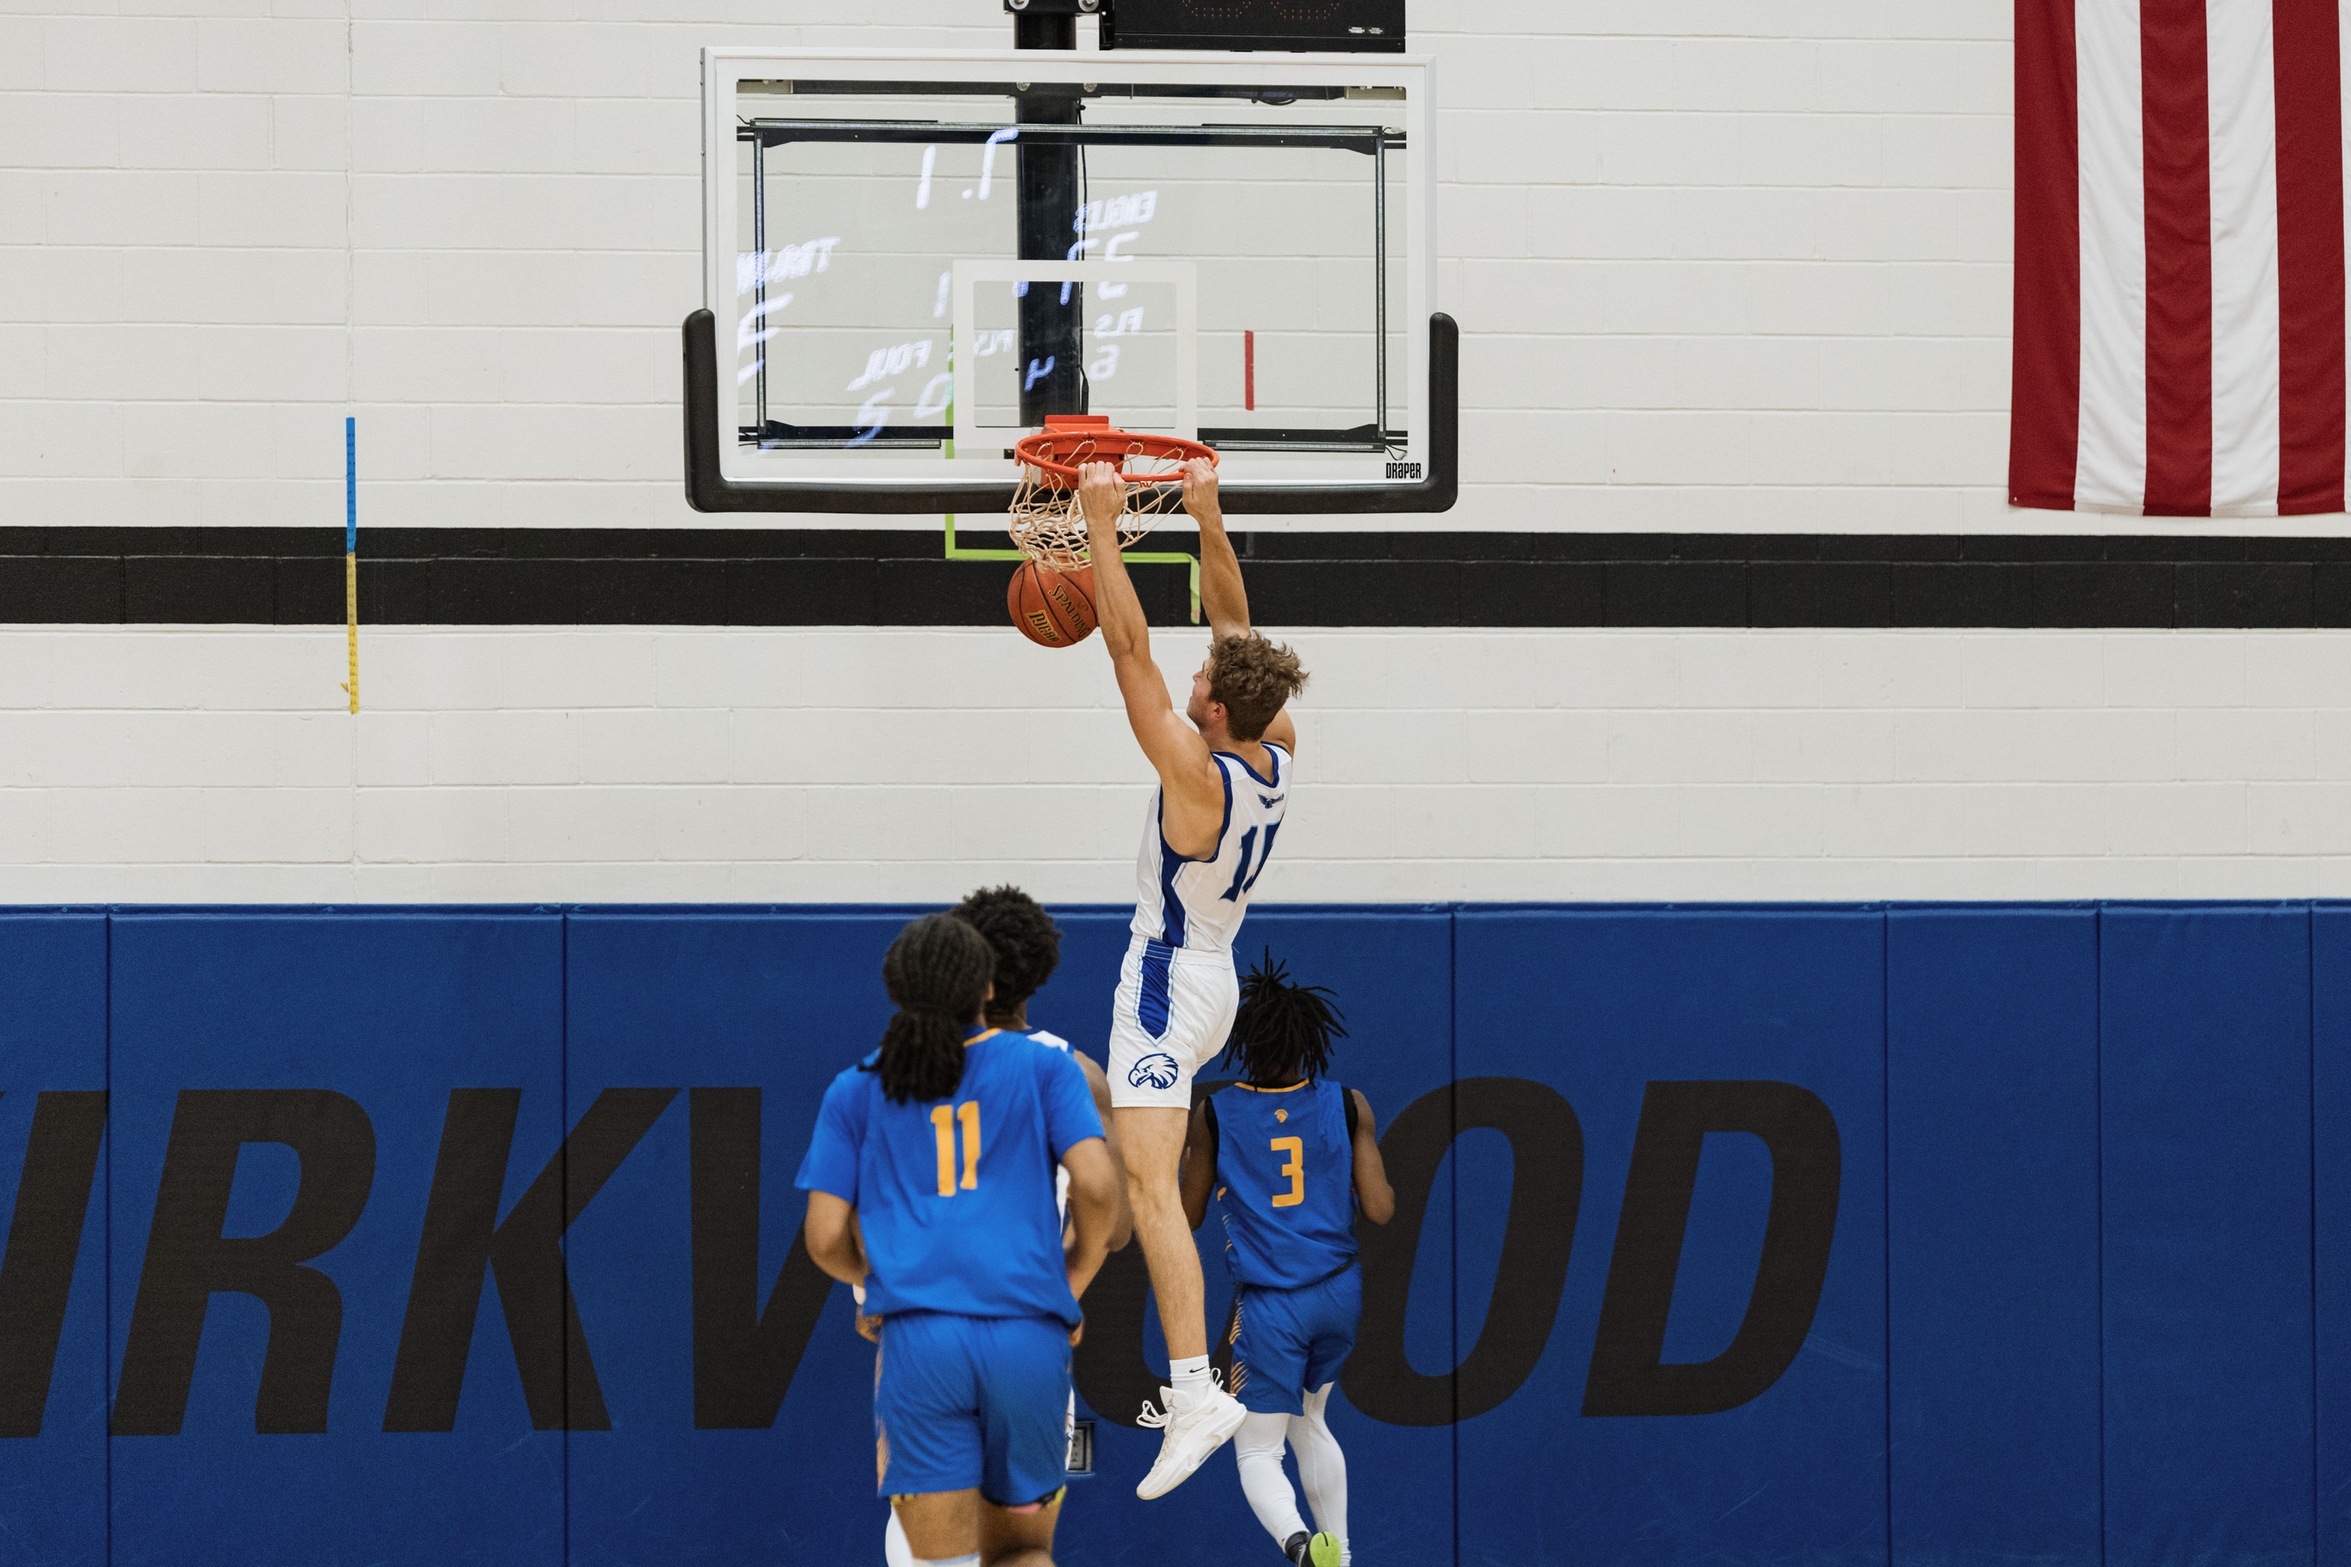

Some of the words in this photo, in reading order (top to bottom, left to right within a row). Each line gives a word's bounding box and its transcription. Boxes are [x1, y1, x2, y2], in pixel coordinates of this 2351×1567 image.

[1048, 583, 1091, 638] SPALDING
[929, 1101, 982, 1197] 11
[1269, 1136, 1304, 1207] 3
[0, 1076, 1841, 1438] IRKOD
